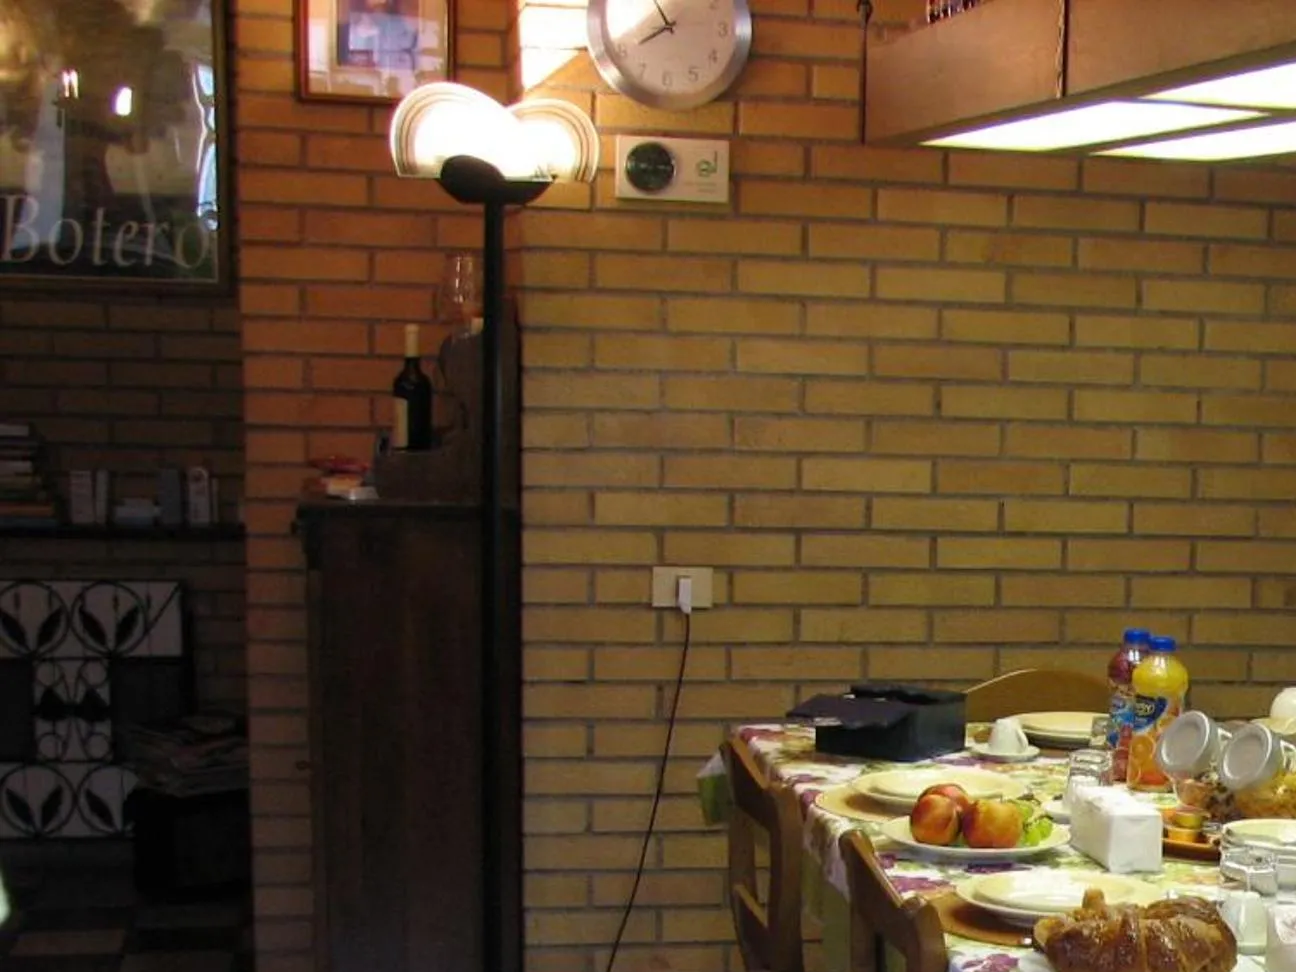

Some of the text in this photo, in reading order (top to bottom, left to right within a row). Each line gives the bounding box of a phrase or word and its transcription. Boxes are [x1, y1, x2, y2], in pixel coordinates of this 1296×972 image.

[717, 22, 728, 38] 3
[708, 50, 718, 64] 4
[638, 63, 647, 80] 7
[661, 72, 672, 87] 6
[688, 66, 700, 82] 5
[0, 194, 210, 268] Botero
